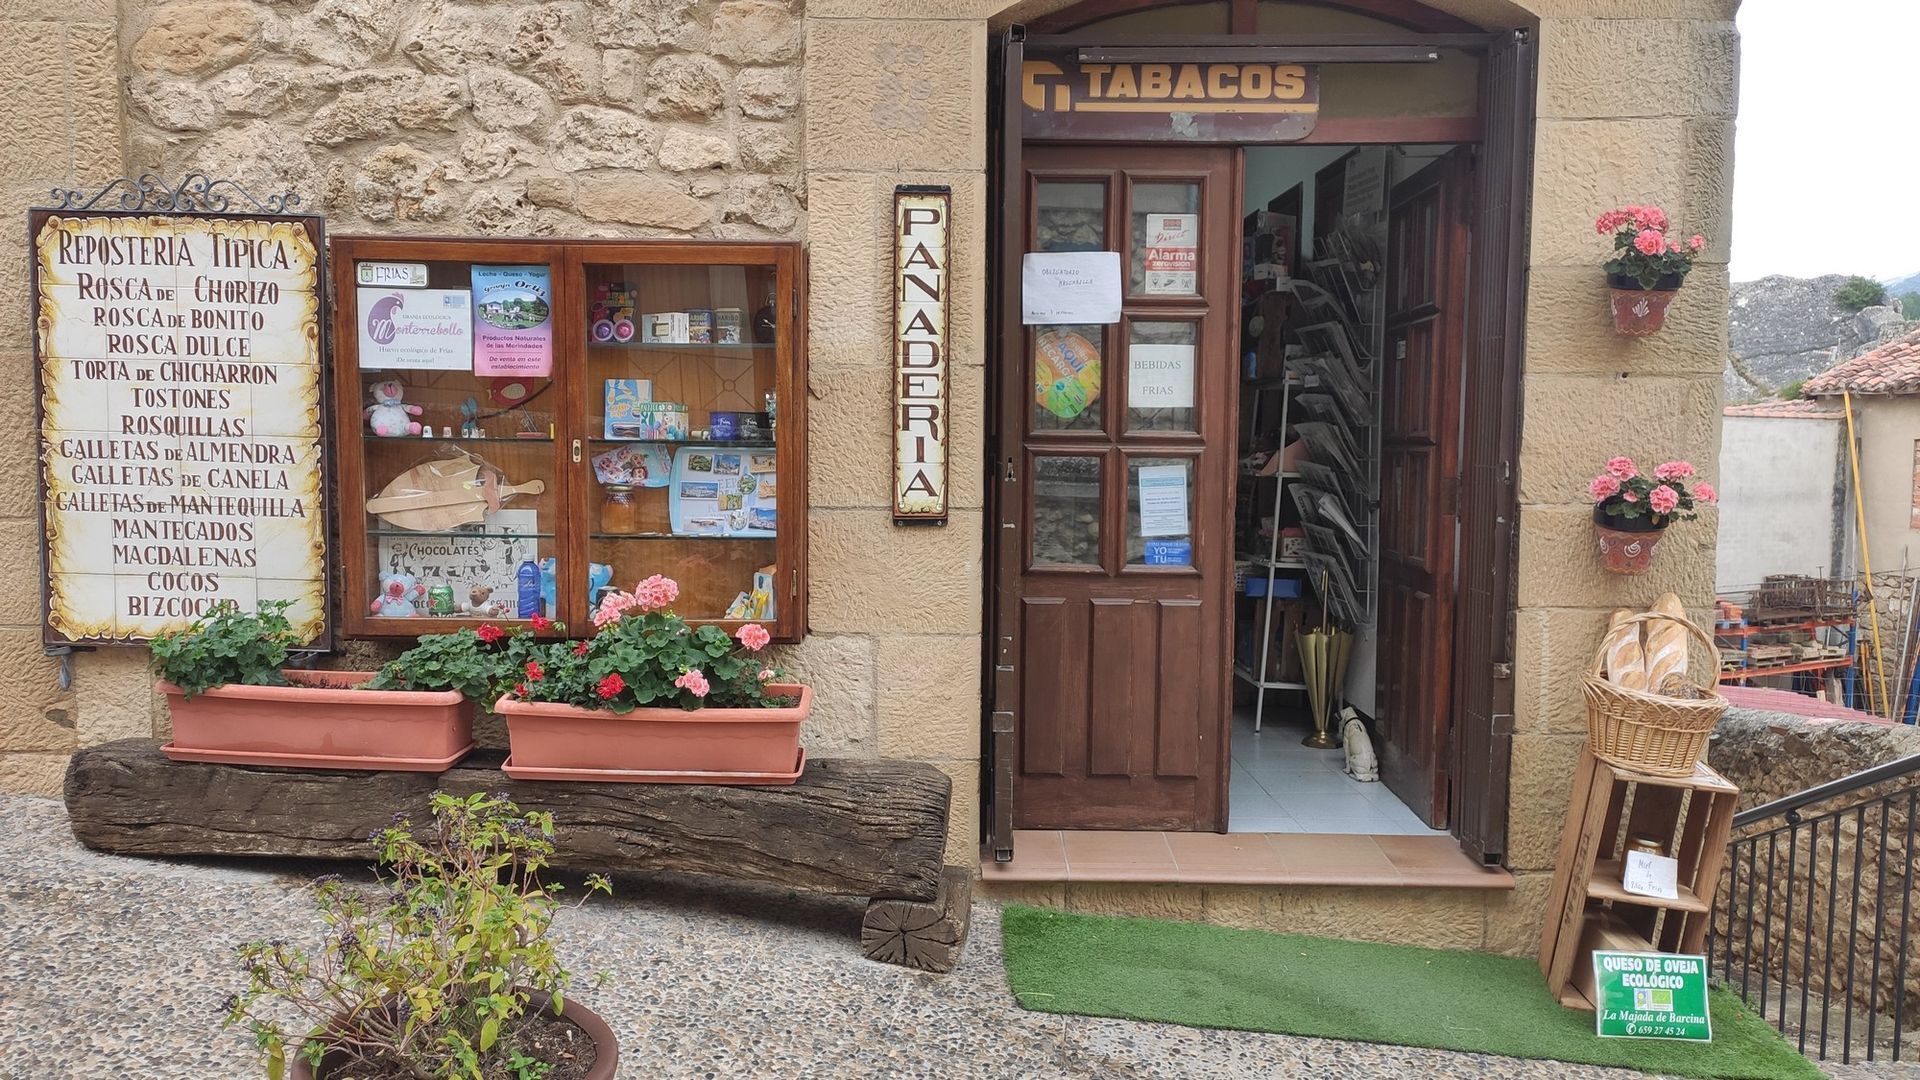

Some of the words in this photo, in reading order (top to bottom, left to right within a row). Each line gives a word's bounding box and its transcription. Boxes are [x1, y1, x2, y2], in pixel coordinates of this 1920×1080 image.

[1081, 64, 1306, 99] TABACOS
[58, 229, 195, 267] REPOSTERIA
[1149, 248, 1195, 261] Alarma
[376, 266, 409, 282] FRIAS
[77, 273, 152, 301] ROSCA
[156, 289, 175, 301] DE
[194, 274, 279, 305] CHORIZO
[515, 280, 546, 297] Ortiz
[94, 306, 165, 328] ROSCA
[167, 315, 186, 328] DE
[190, 309, 264, 331] BONITO
[107, 334, 177, 355] ROSCA
[186, 336, 250, 358] DULCE
[902, 207, 940, 497] PANADERIA
[1038, 338, 1073, 383] RECARGA
[1134, 360, 1182, 369] BEBIDAS
[71, 360, 130, 381] TORTA
[136, 368, 155, 382] DE
[160, 362, 277, 384] CHICHARRON
[131, 388, 231, 409] TOSTONES
[122, 415, 246, 438] ROSQUILLAS
[60, 440, 159, 461] GALLETAS
[164, 448, 183, 461] DE
[187, 442, 296, 464] ALMENDRA
[71, 465, 174, 487] GALLETAS
[181, 474, 201, 487] DE
[207, 468, 289, 490] CANELA
[56, 491, 144, 513] GALLETAS
[147, 500, 166, 514] DE
[170, 495, 305, 518] MANTEQUILLA
[112, 519, 254, 541] MANTECADOS
[113, 545, 257, 568] MAGDALENAS
[409, 543, 479, 560] CHOCOLATES
[1153, 546, 1167, 555] YO
[147, 572, 219, 593] COCOS
[1603, 956, 1643, 972] QUESO
[1646, 958, 1661, 972] DE
[1664, 960, 1699, 974] OVEJA
[1622, 971, 1684, 989] ECOLÓGICO
[1603, 1009, 1617, 1020] La
[1619, 1010, 1654, 1024] Majada
[1656, 1012, 1667, 1022] de
[1669, 1013, 1705, 1024] Barcina
[1638, 1026, 1652, 1034] 659
[1653, 1027, 1663, 1035] 27
[1664, 1027, 1675, 1035] 45
[1675, 1027, 1686, 1036] 24
